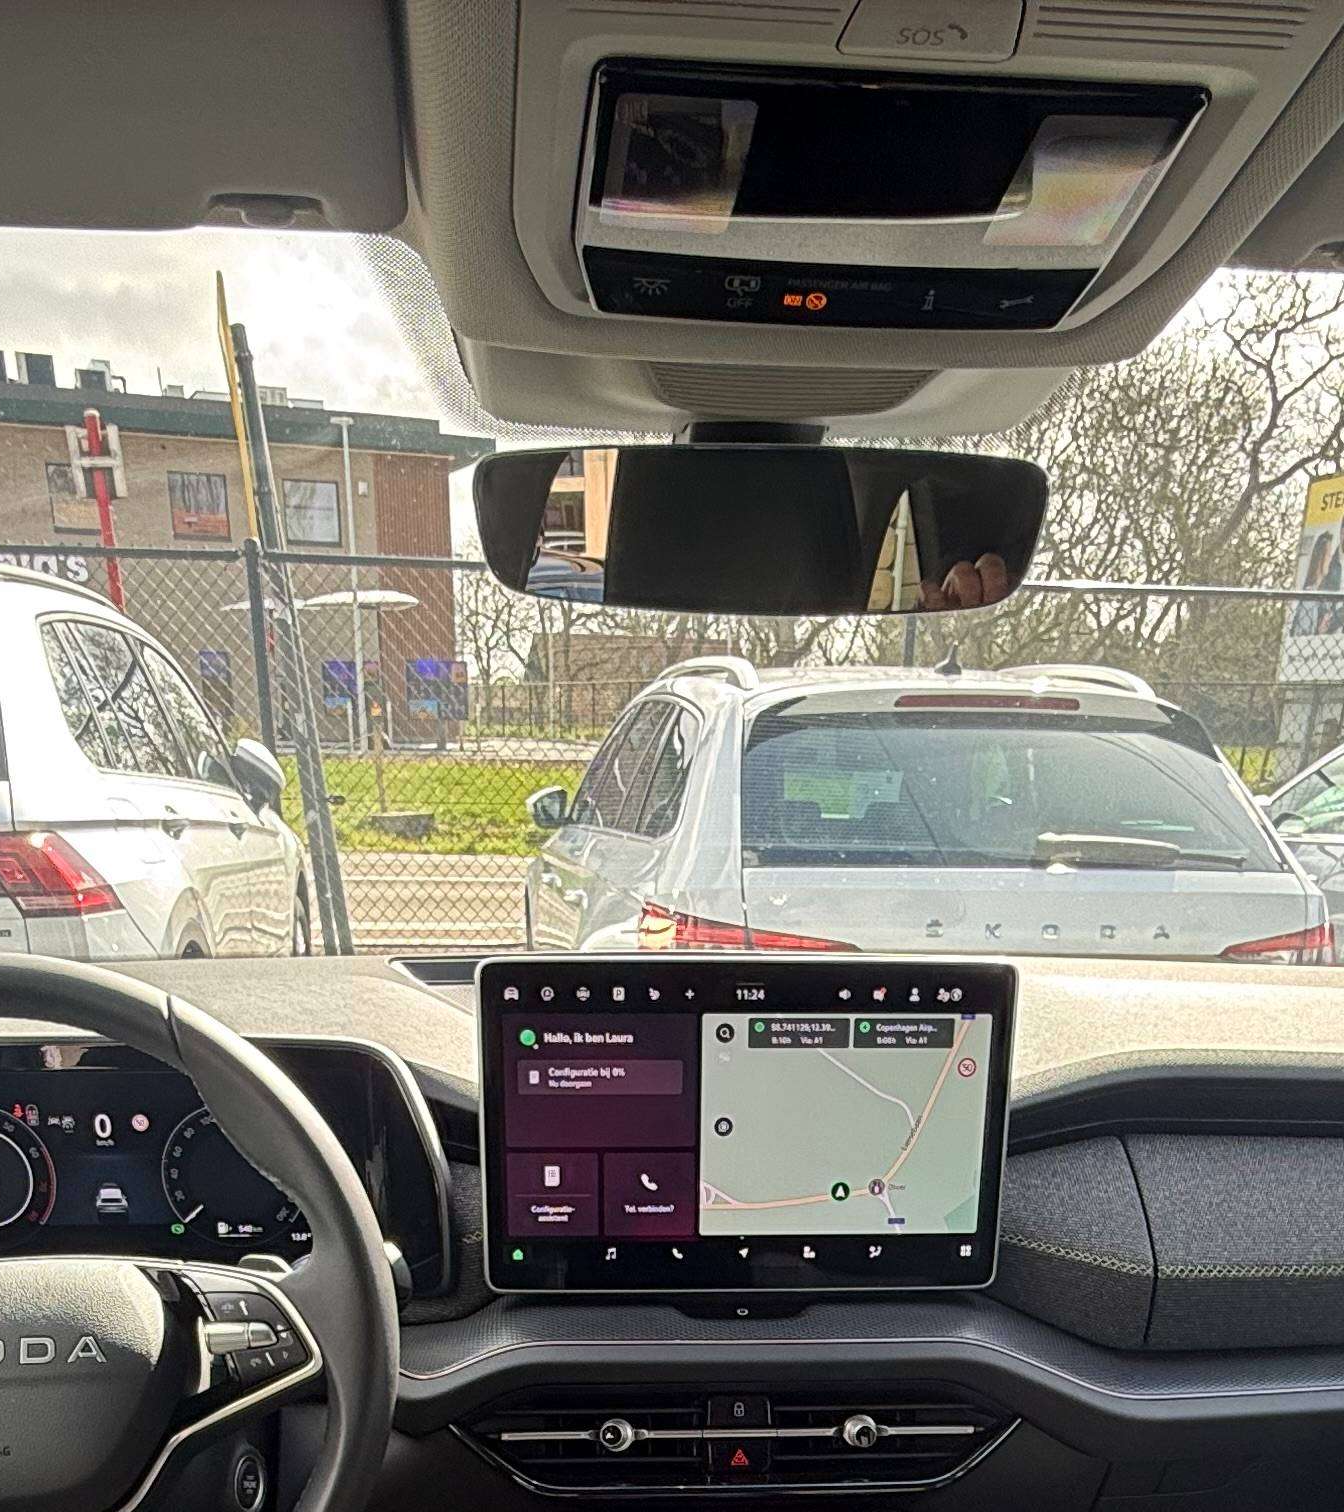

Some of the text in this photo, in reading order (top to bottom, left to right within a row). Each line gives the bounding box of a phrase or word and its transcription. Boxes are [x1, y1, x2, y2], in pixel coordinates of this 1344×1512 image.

[896, 27, 944, 46] SOS
[736, 988, 765, 1000] 11:24
[543, 1032, 573, 1045] Hallo,
[585, 1032, 605, 1043] ben
[605, 1032, 634, 1043] Laura
[547, 1067, 599, 1079] Configuratie
[94, 1113, 113, 1139] 0
